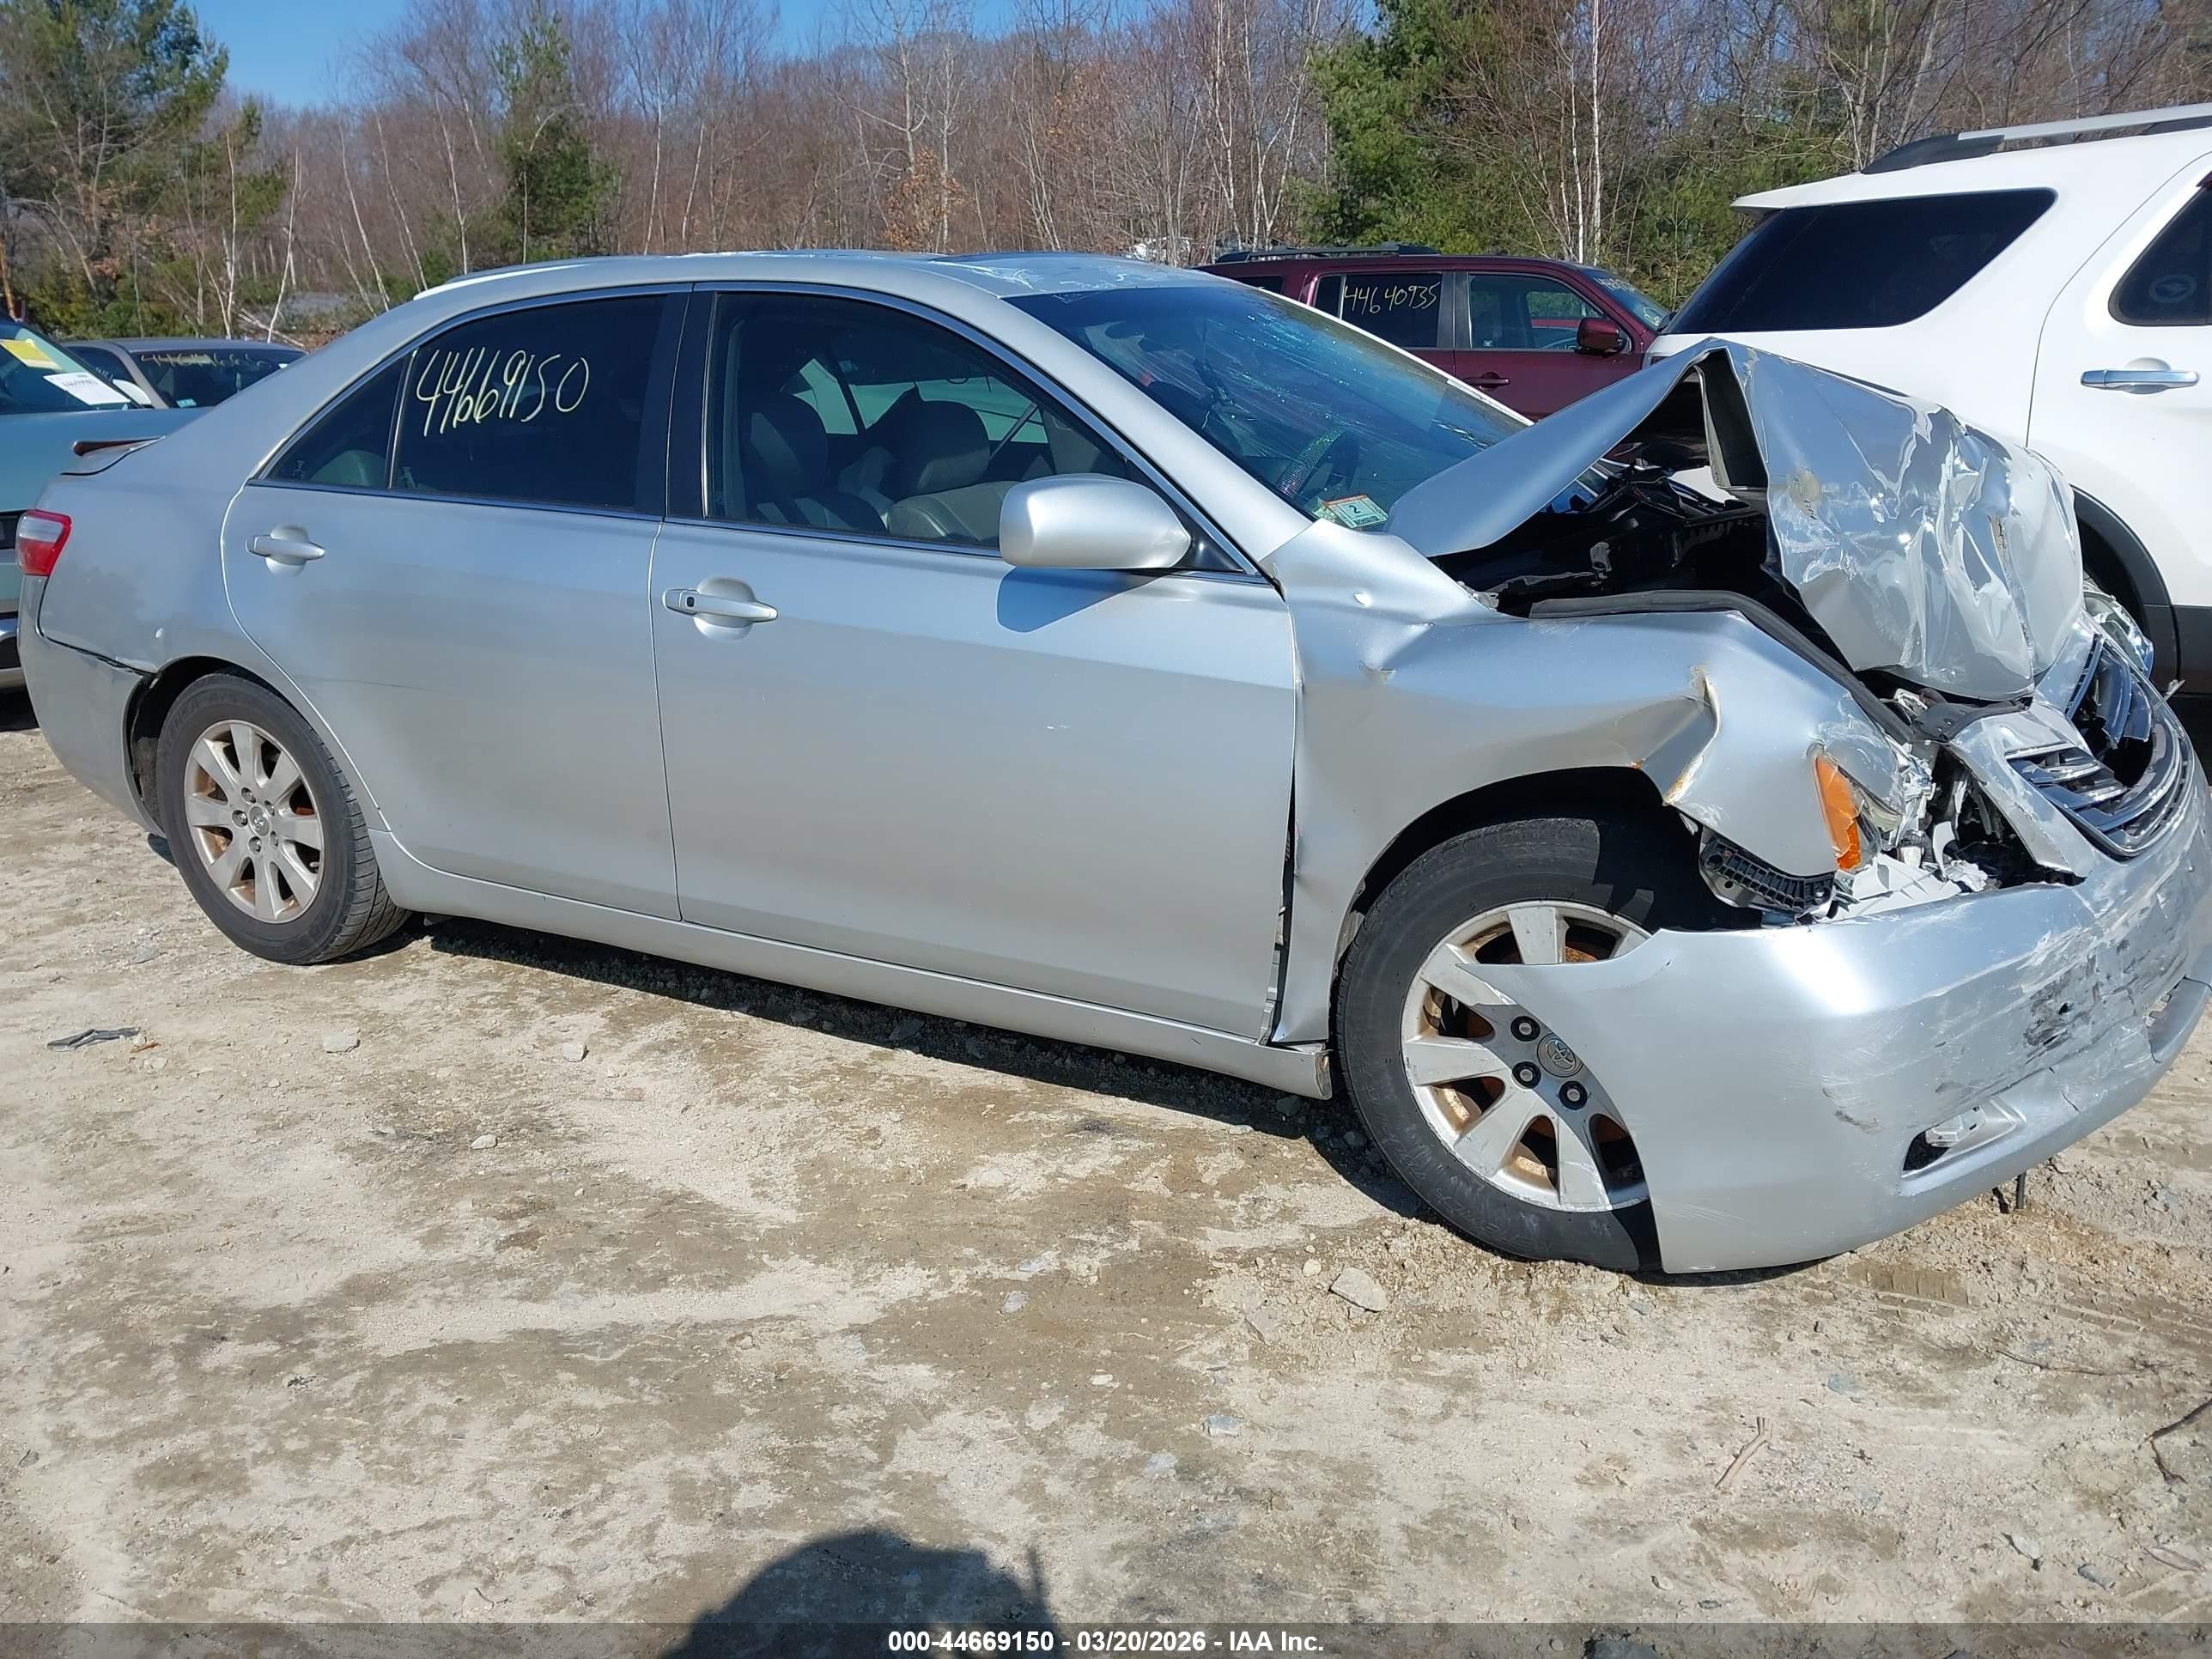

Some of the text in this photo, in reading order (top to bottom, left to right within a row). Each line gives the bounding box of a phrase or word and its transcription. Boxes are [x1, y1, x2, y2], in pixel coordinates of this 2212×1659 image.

[1344, 282, 1441, 315] 44640935
[416, 346, 590, 437] 44669150
[1348, 504, 1362, 514] 2
